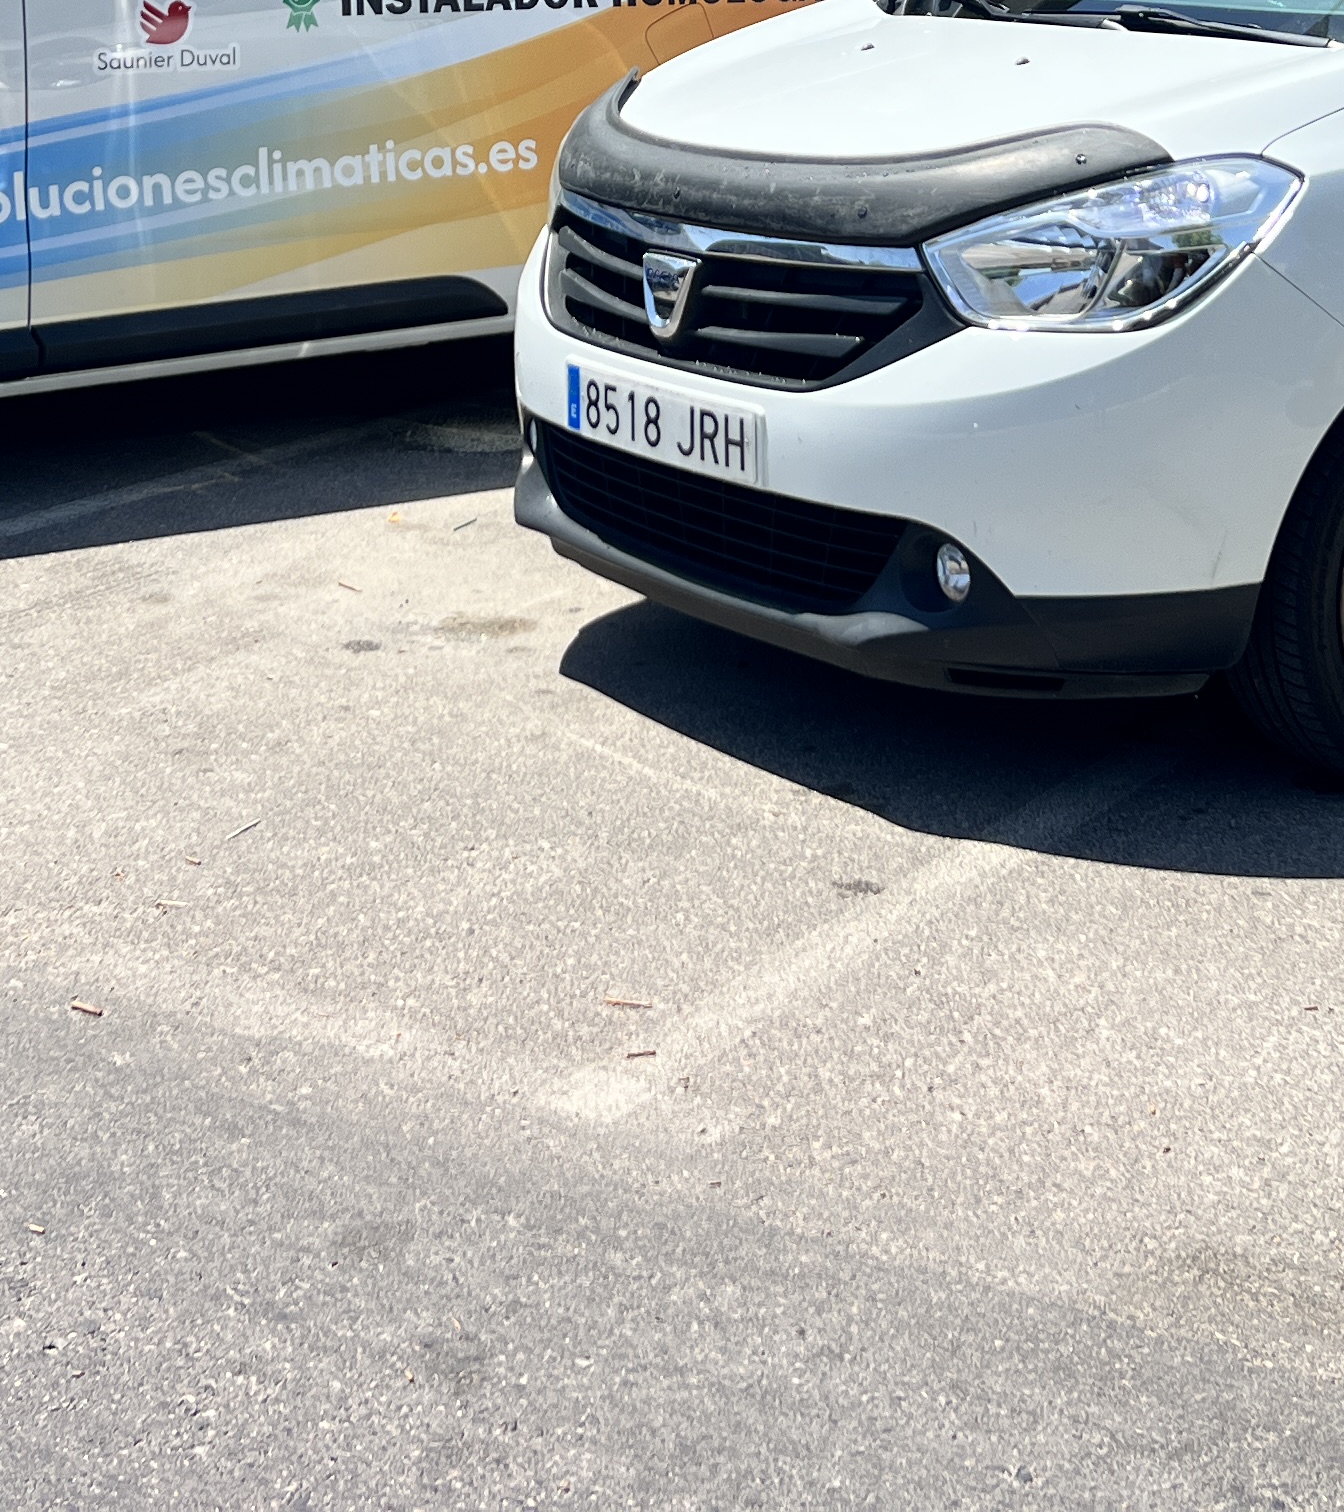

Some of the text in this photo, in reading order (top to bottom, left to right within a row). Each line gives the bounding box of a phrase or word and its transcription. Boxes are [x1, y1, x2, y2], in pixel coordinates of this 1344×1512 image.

[98, 47, 236, 71] Saunier Duval
[586, 379, 745, 471] 8518 JRH
